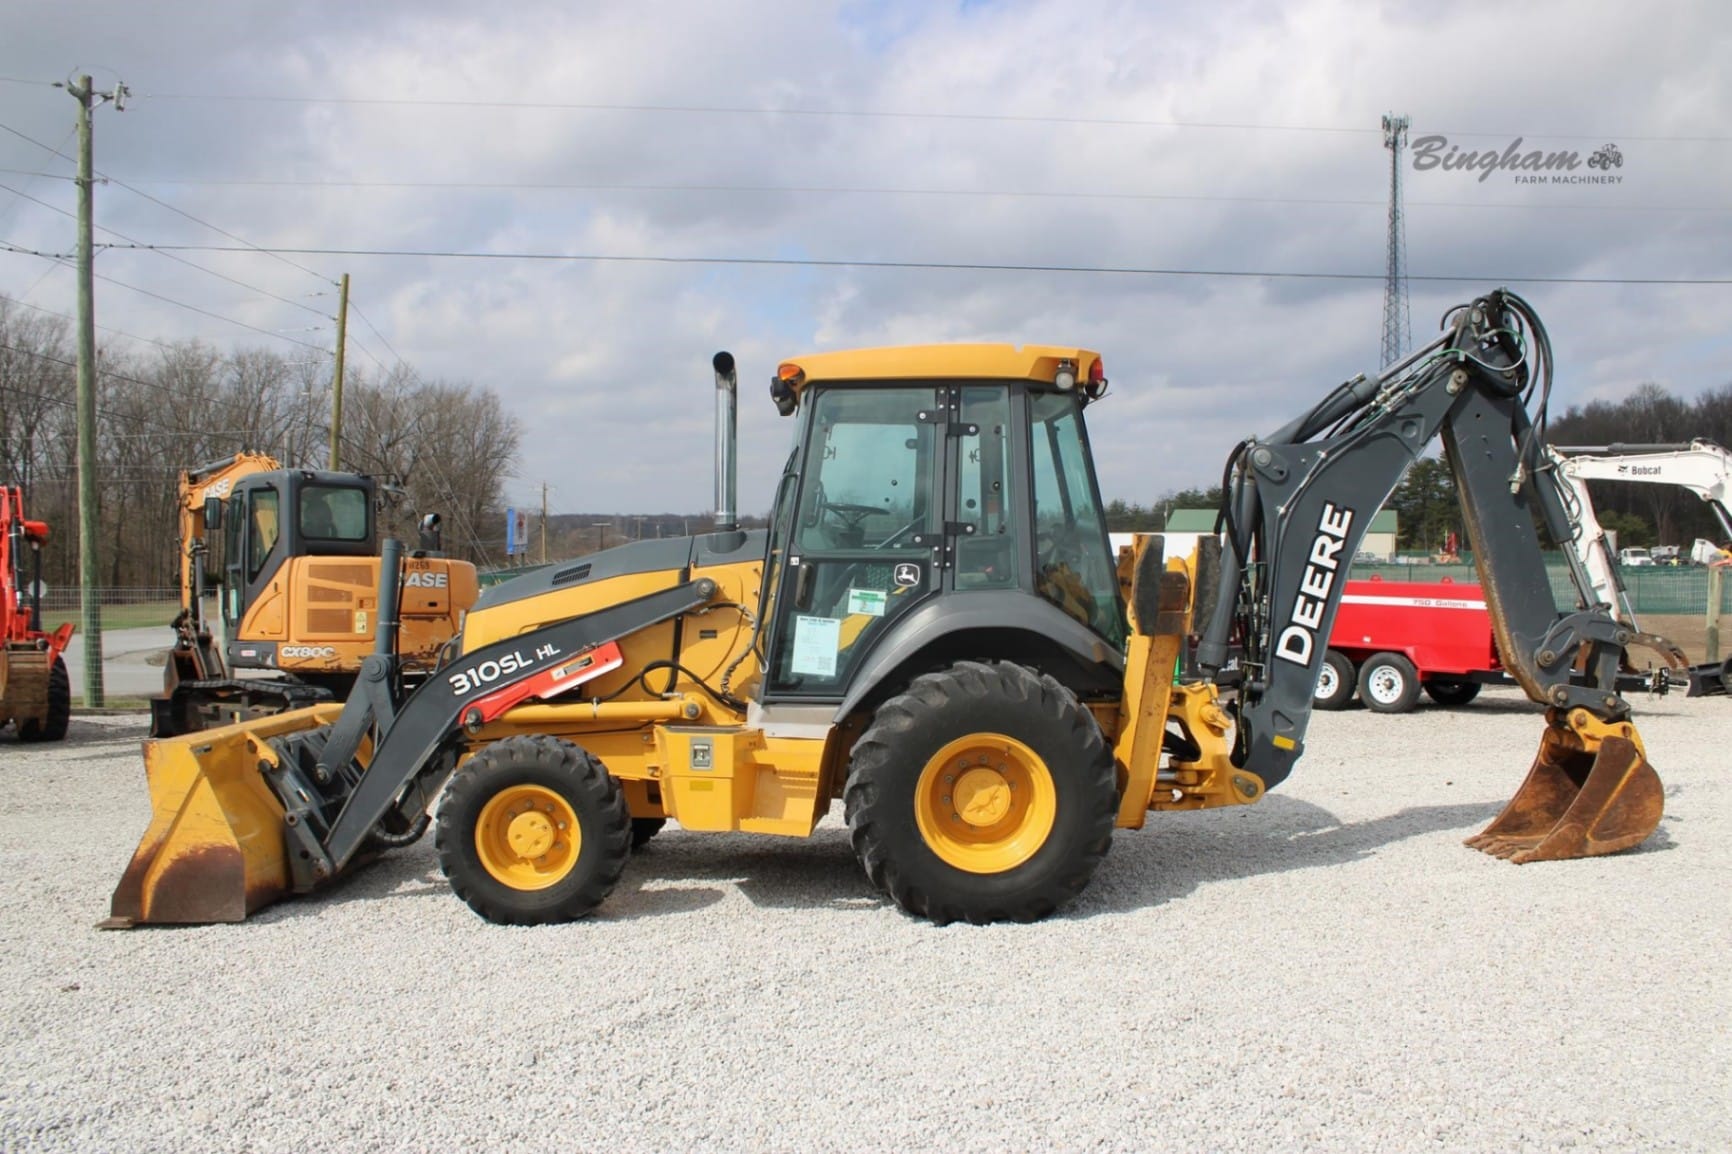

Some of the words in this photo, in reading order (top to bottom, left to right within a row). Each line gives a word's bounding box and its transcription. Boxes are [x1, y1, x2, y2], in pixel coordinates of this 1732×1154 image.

[1631, 466, 1662, 476] Bobcat
[404, 572, 448, 588] ASE
[1275, 503, 1353, 666] DEERE
[449, 651, 534, 696] 310SL
[536, 643, 561, 661] HL
